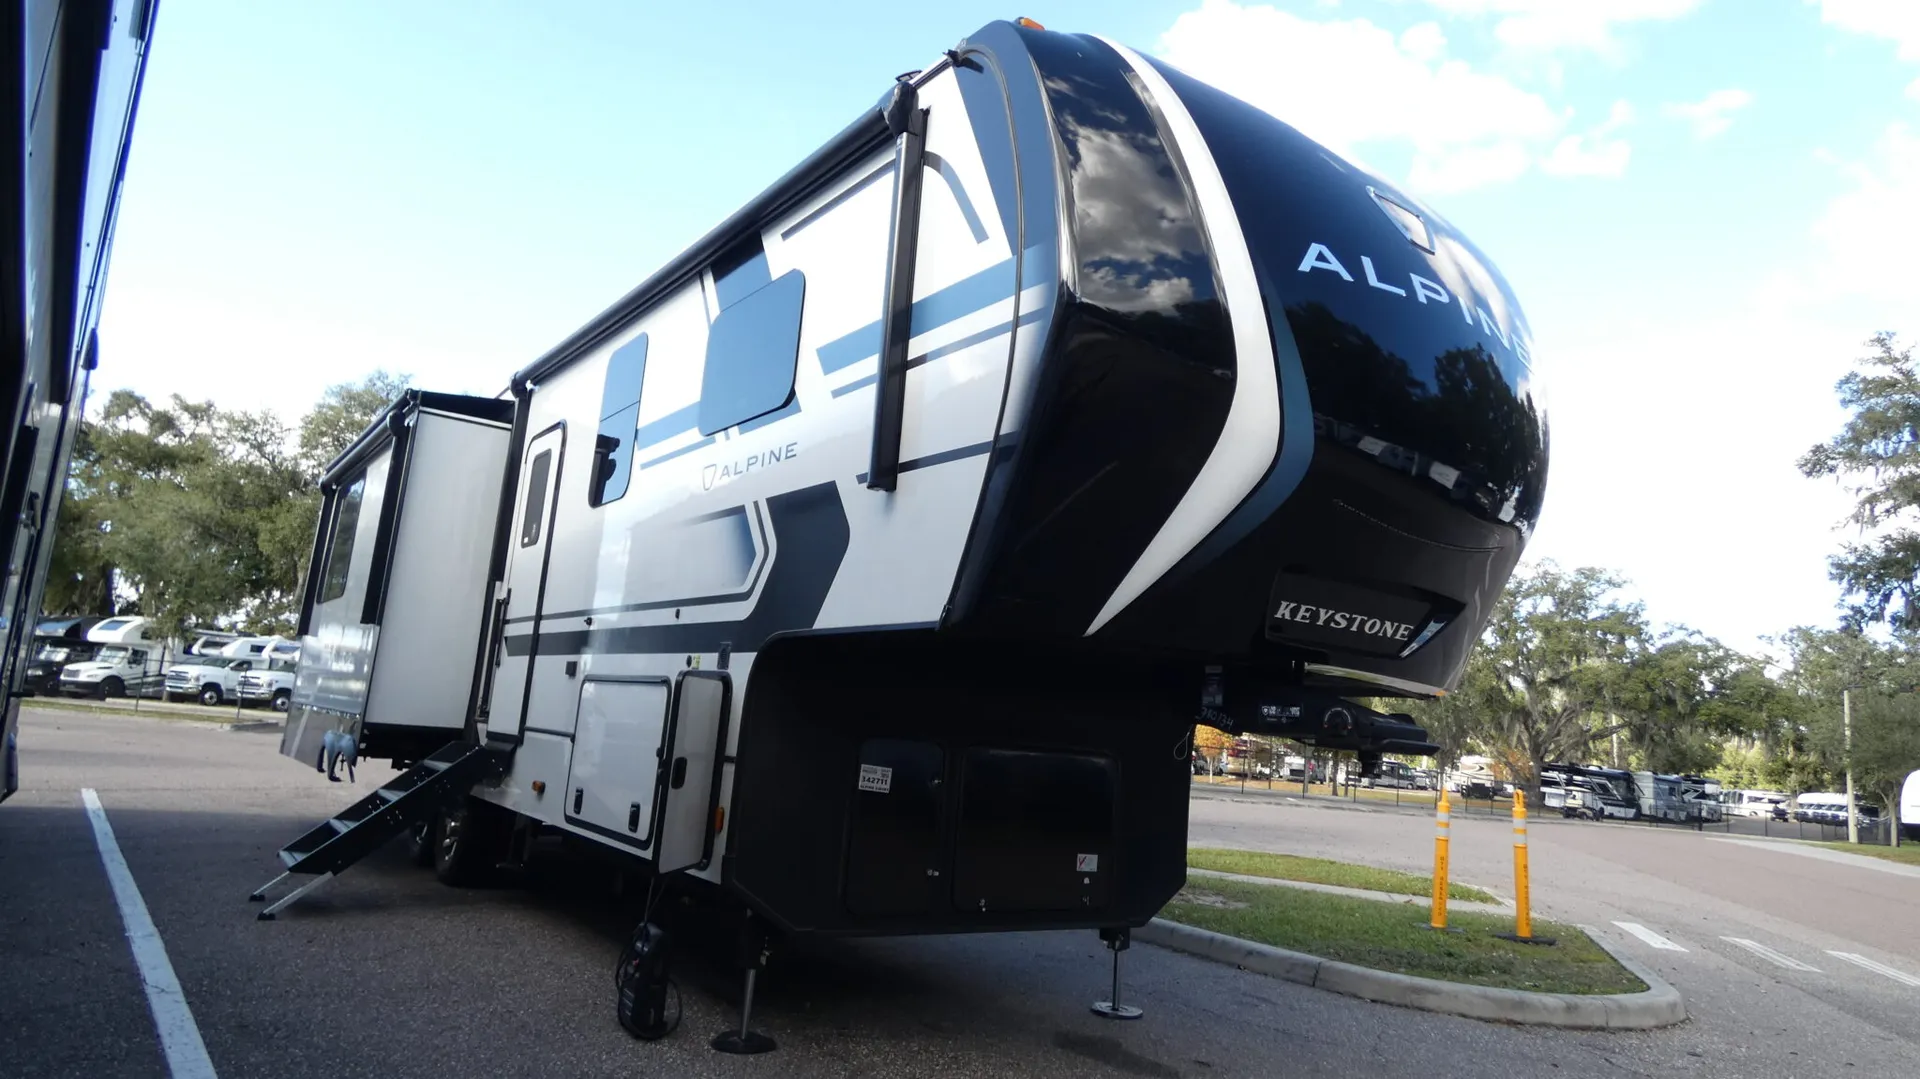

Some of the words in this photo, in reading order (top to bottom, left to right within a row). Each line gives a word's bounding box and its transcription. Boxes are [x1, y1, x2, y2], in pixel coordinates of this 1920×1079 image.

[1297, 242, 1535, 374] ALPINE
[719, 442, 798, 480] ALPINE
[1274, 600, 1415, 641] KEYSTONE
